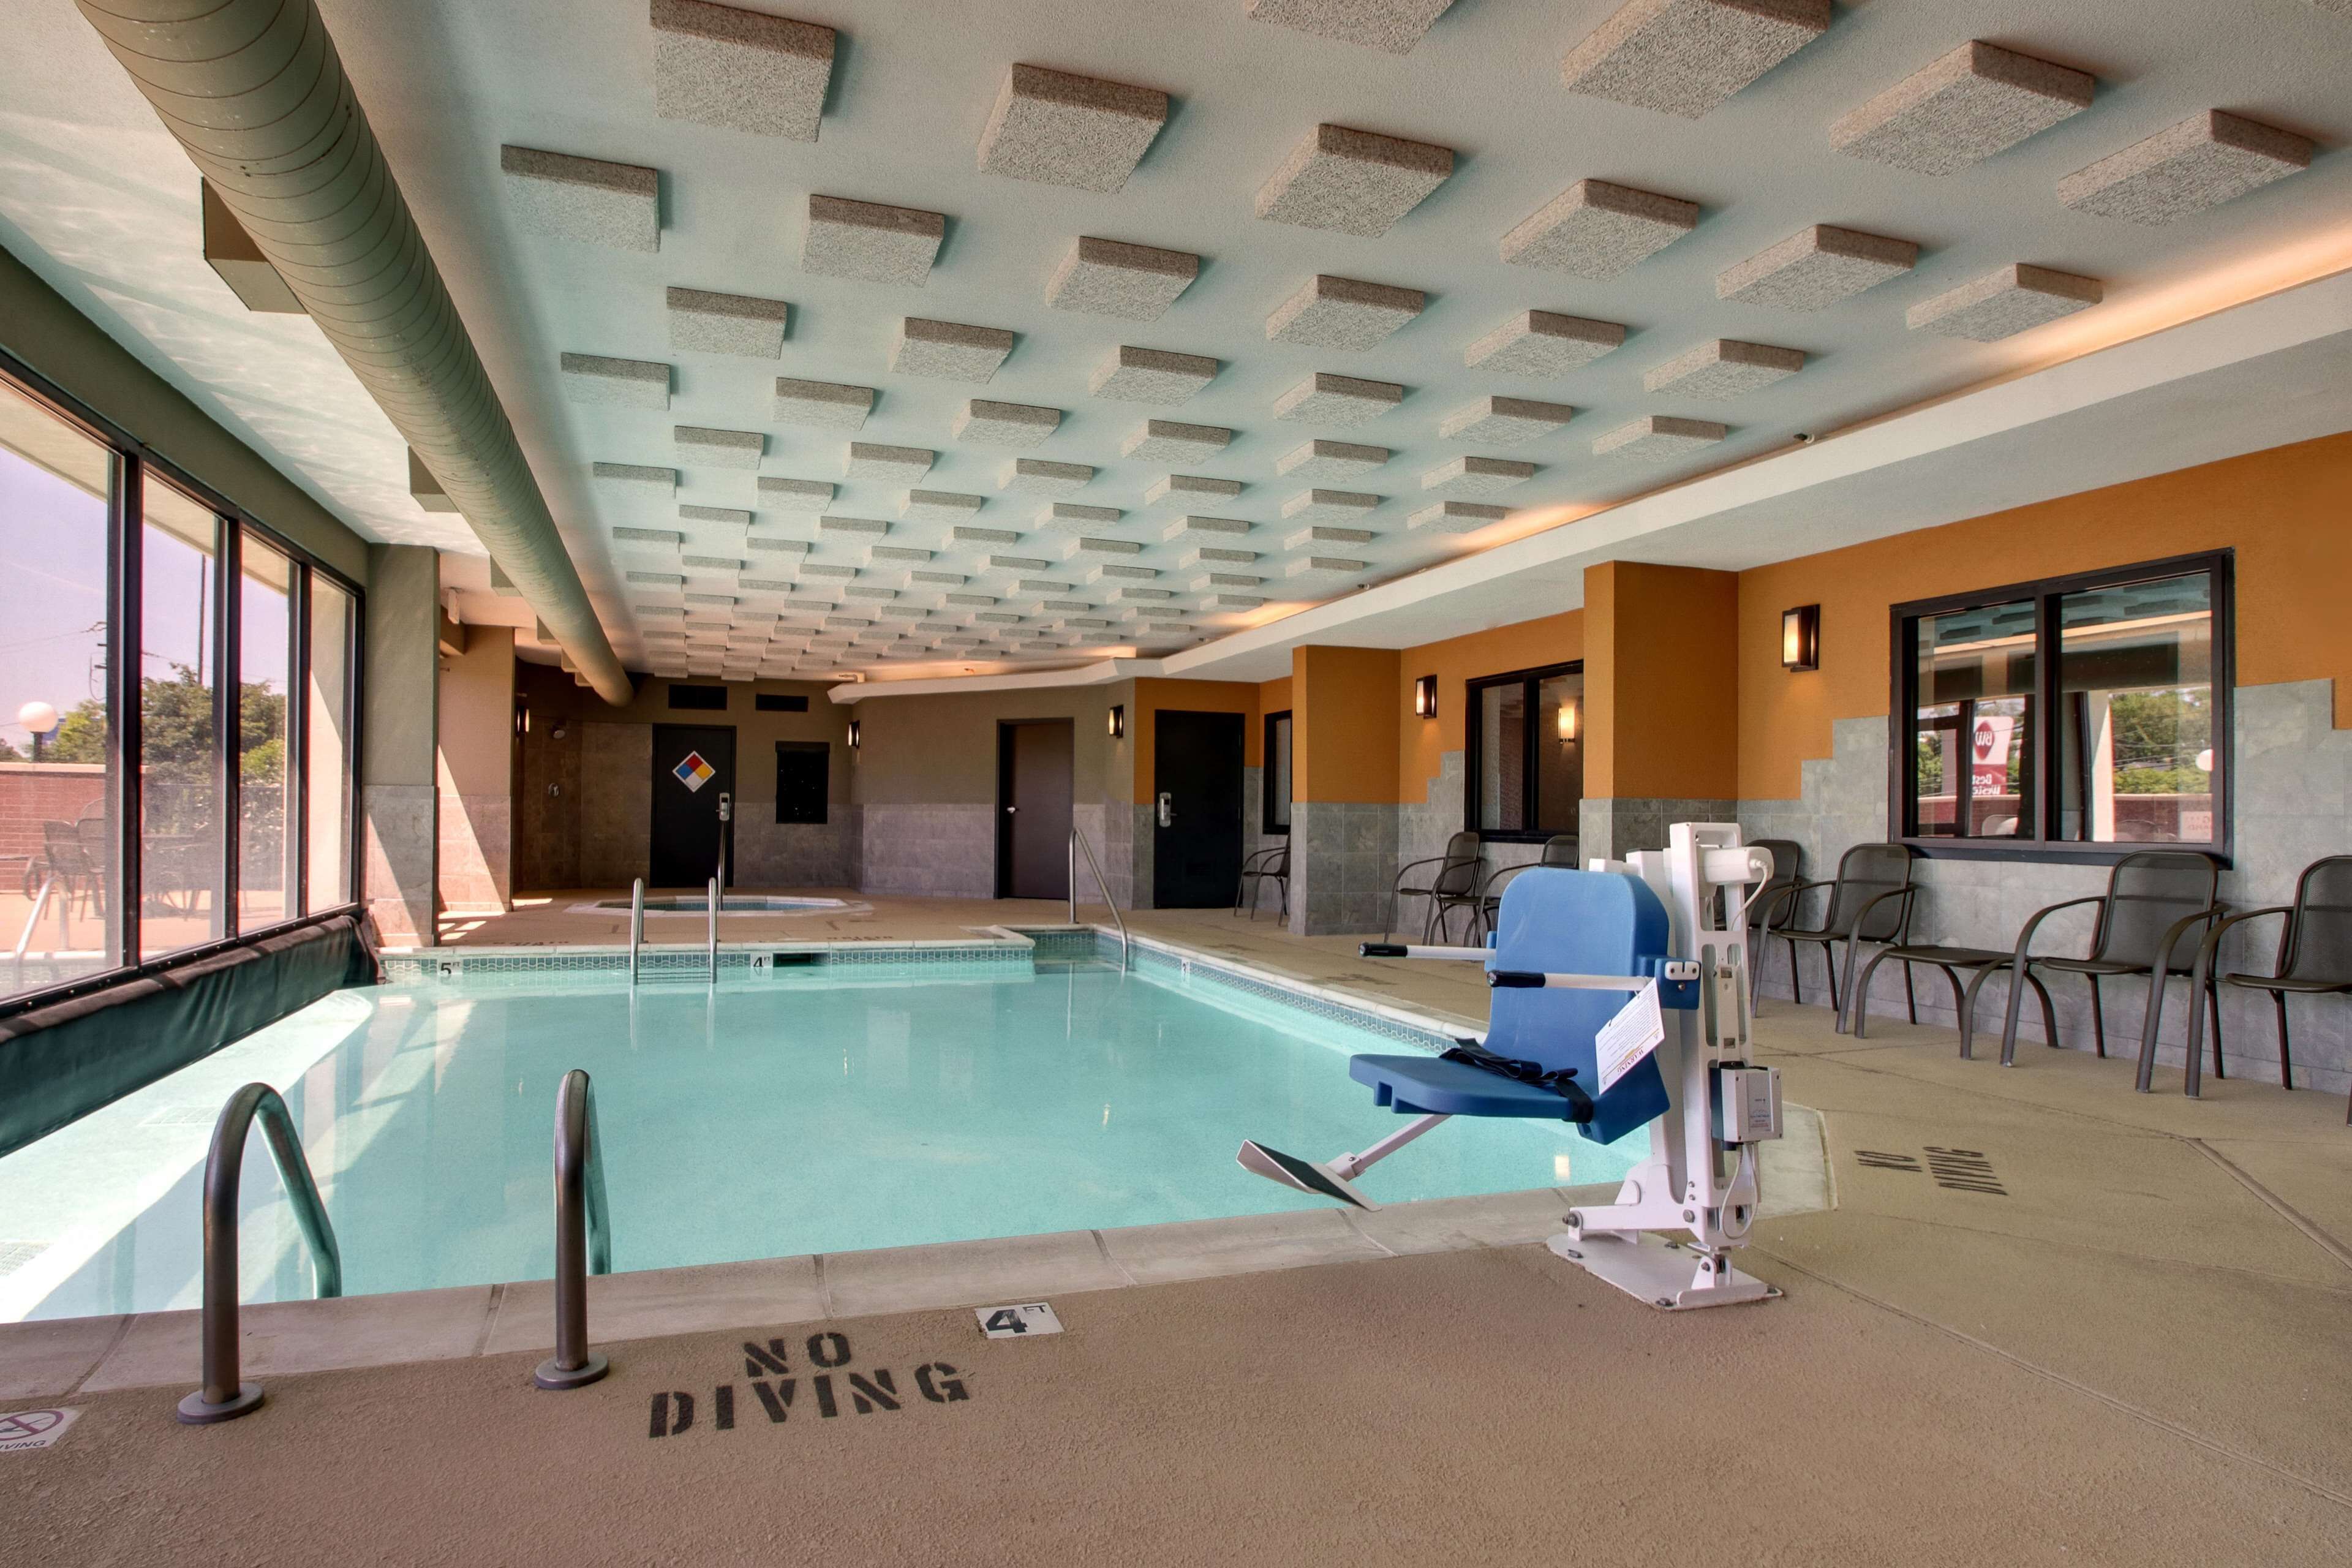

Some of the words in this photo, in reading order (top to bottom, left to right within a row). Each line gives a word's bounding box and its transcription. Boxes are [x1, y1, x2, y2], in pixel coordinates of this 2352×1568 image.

[1617, 1049, 1644, 1073] WARNING
[986, 1309, 1028, 1334] 4
[743, 1332, 852, 1378] NO
[649, 1361, 970, 1439] DIVING
